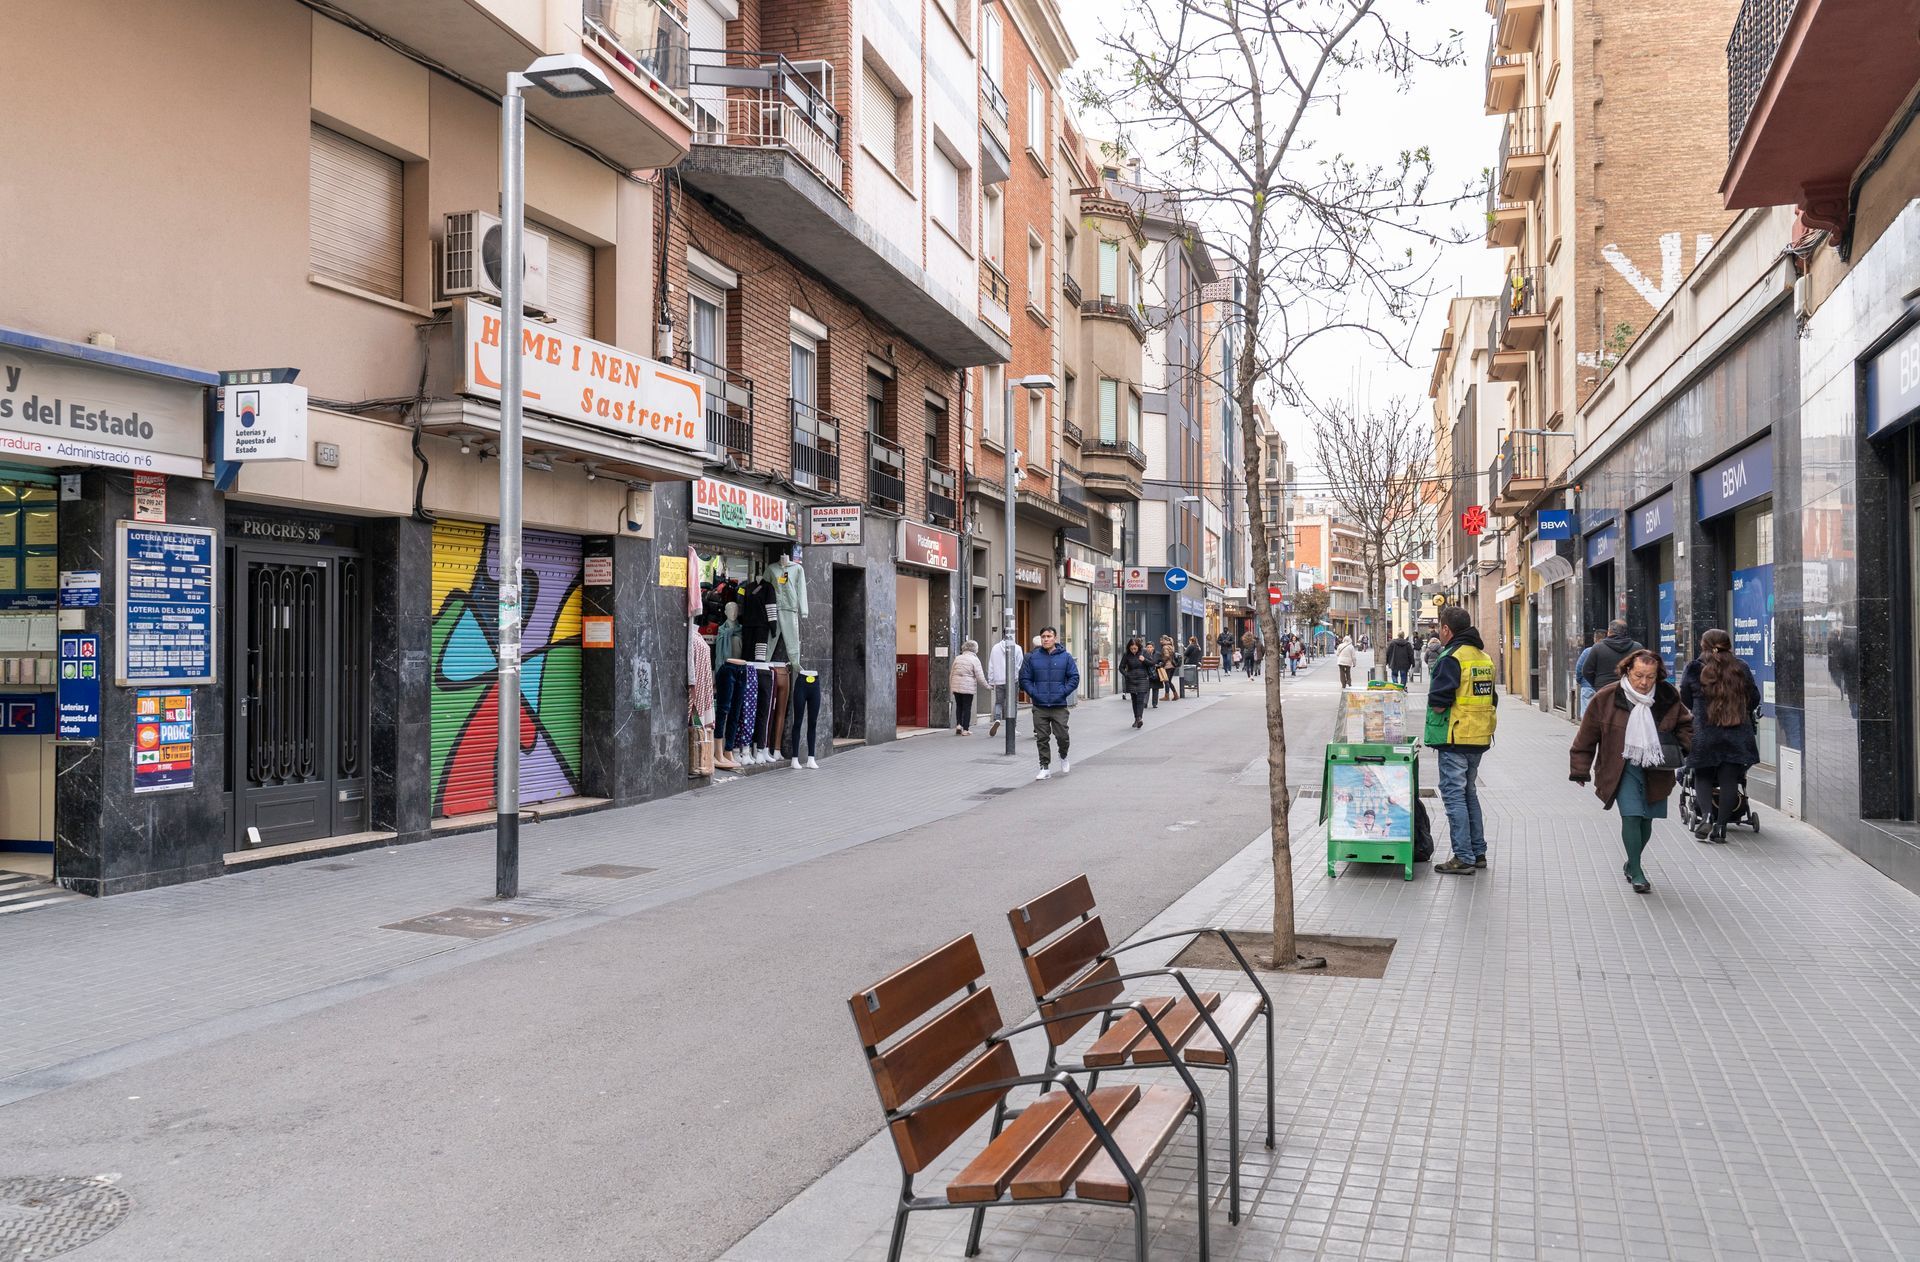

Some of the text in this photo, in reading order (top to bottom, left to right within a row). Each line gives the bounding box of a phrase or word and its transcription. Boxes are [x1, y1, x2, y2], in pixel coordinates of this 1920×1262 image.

[481, 314, 641, 389] HME I NEN
[6, 365, 21, 392] y
[22, 394, 62, 426] del
[69, 403, 153, 440] Estado
[580, 387, 695, 440] Sastreria
[235, 429, 262, 437] Loterías
[236, 436, 276, 446] Apuestas del
[56, 442, 130, 464] Administració
[235, 446, 257, 454] Estado
[323, 447, 335, 462] 58
[1722, 459, 1747, 498] BBVA
[697, 479, 784, 523] BASAR RUBI
[813, 507, 859, 516] BASAR RUBI
[1540, 520, 1568, 529] BBVA
[1645, 505, 1661, 534] BBVA
[308, 527, 321, 541] 58
[178, 537, 206, 546] JUEVES
[176, 606, 206, 614] SÁBADO
[60, 703, 89, 712] Loterías y
[60, 714, 97, 723] Apuestas del
[60, 725, 80, 733] Estado
[161, 724, 191, 741] PADRE
